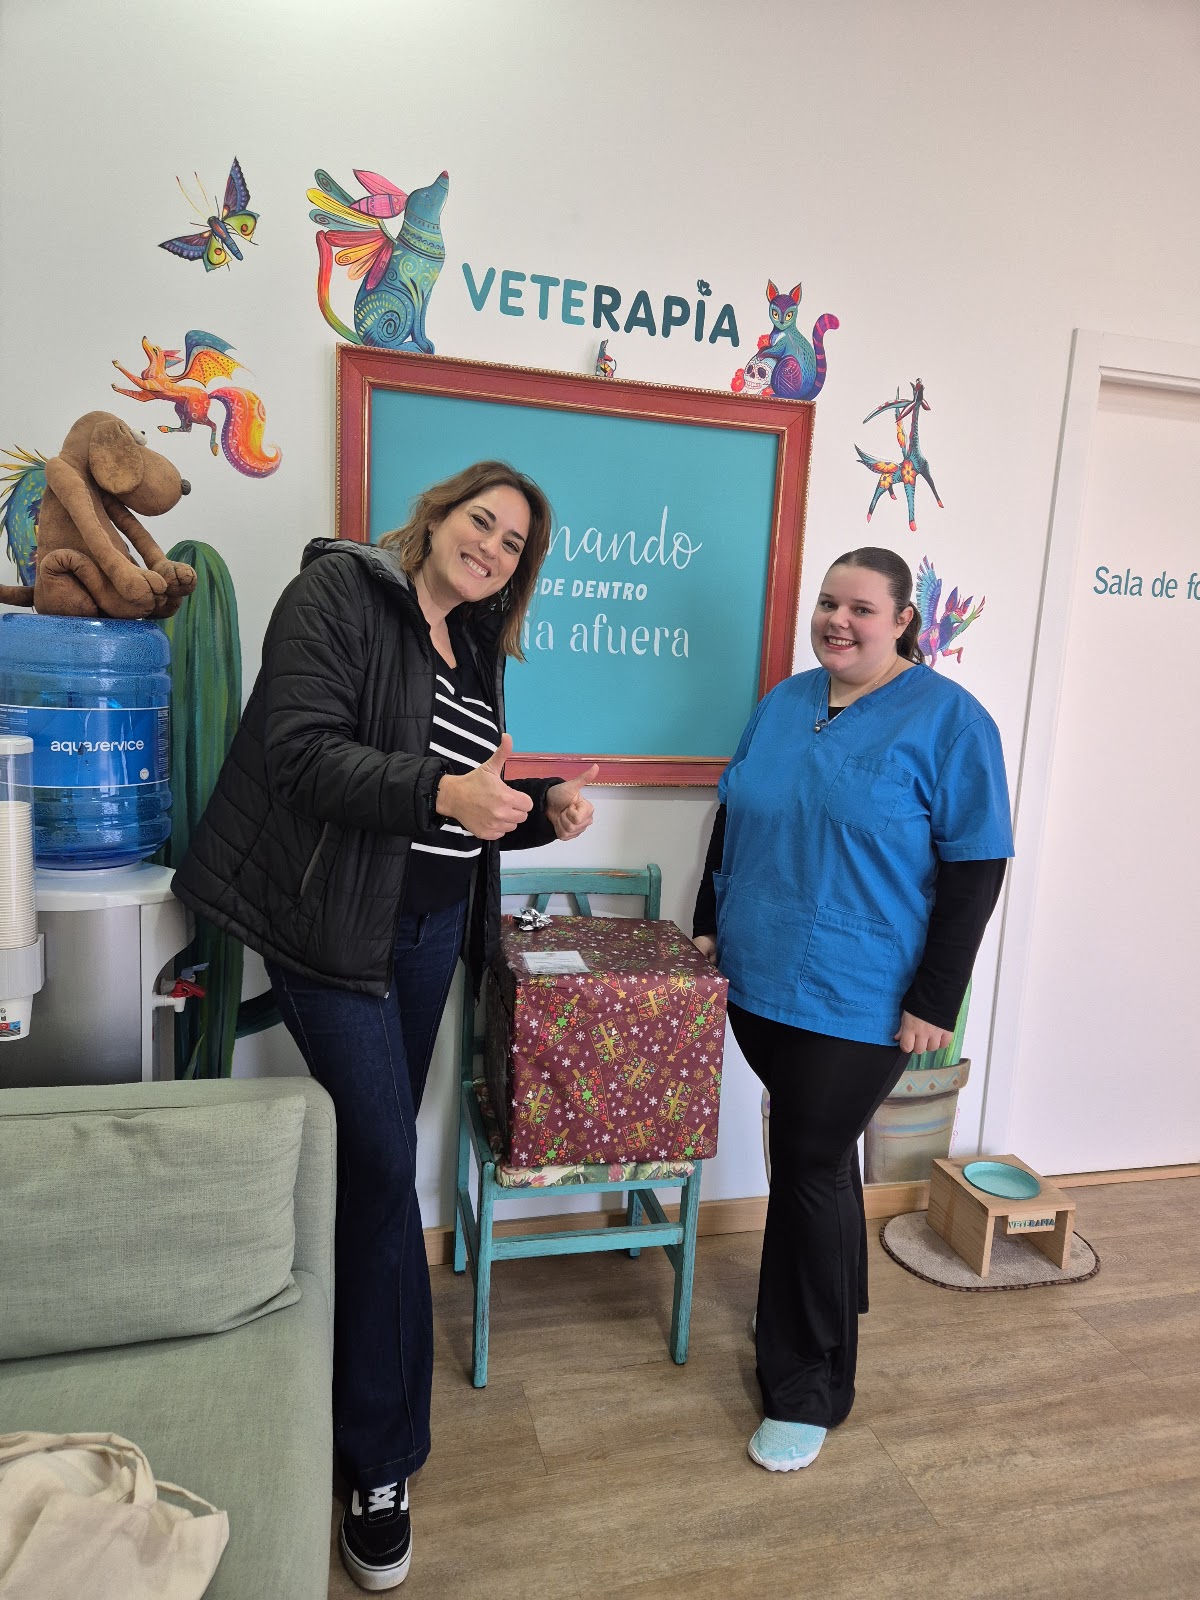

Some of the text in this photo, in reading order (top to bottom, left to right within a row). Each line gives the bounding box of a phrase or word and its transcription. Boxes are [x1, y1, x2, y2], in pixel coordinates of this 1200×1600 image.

[461, 262, 740, 348] VETERAPIA
[546, 505, 702, 570] nando
[534, 578, 648, 601] DE DENTRO
[1093, 566, 1143, 597] Sala
[1151, 570, 1178, 599] de
[523, 609, 689, 659] ia afuera
[50, 740, 145, 756] aquaservice
[1008, 1218, 1055, 1229] VETERAPIA
